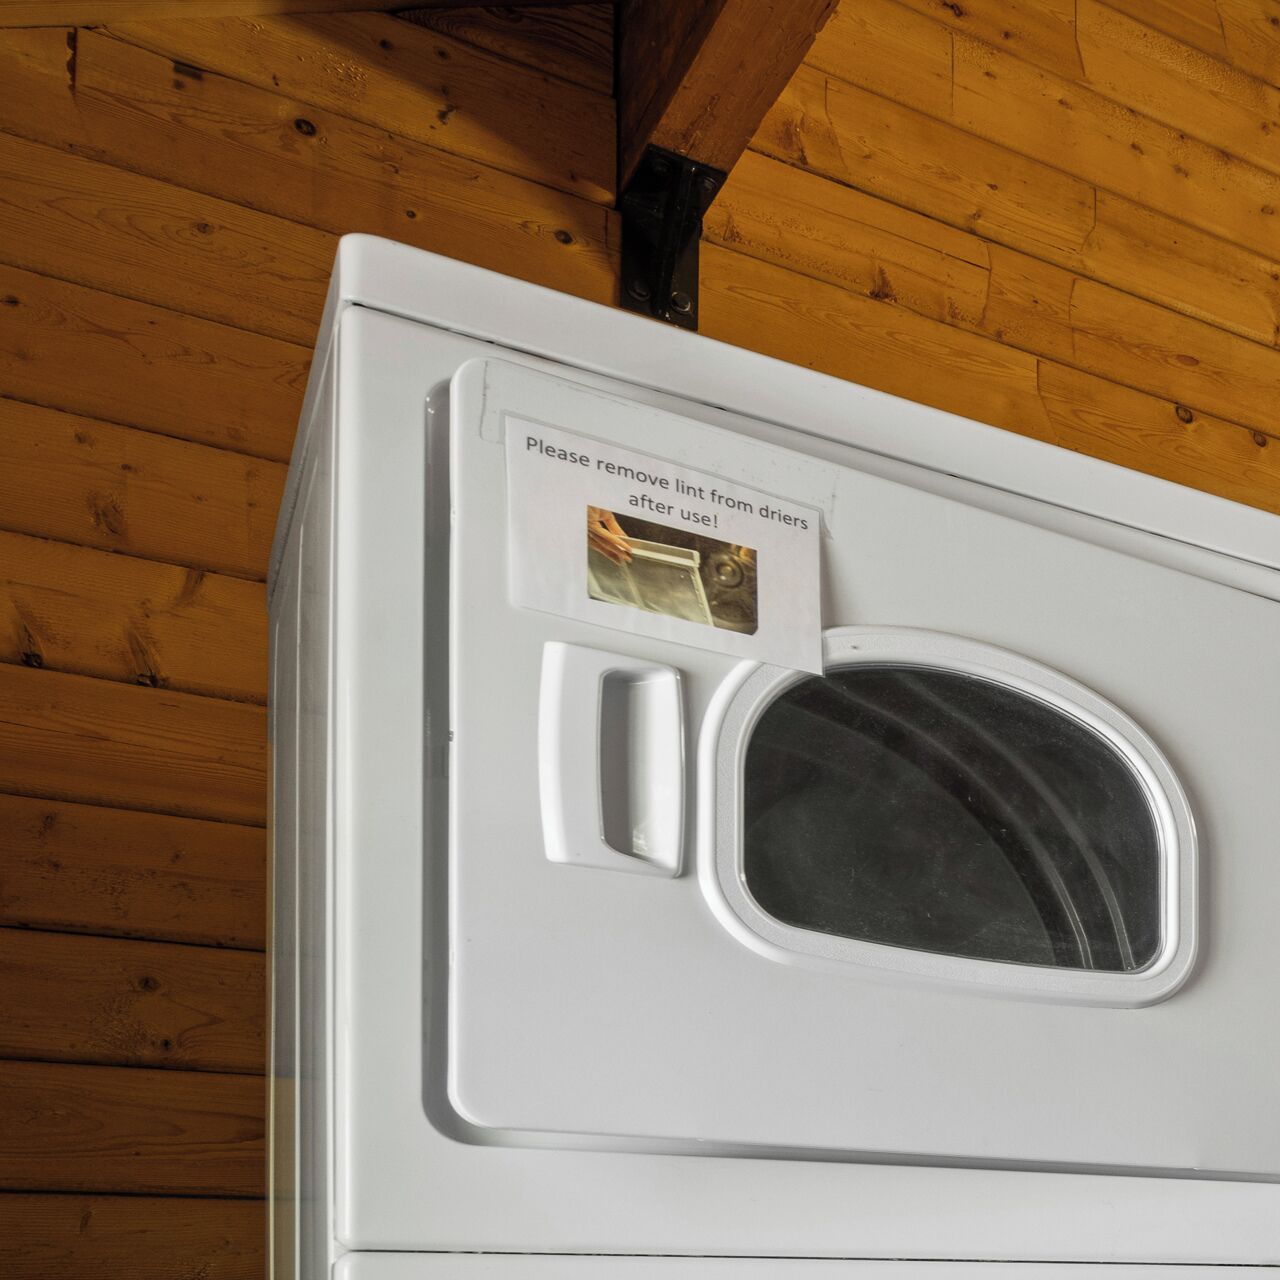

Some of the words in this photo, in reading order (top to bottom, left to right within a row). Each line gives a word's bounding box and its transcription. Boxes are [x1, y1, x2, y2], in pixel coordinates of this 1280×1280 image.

[527, 436, 590, 467] Please
[597, 460, 669, 490] remove
[676, 478, 705, 500] lint
[710, 489, 753, 514] from
[759, 505, 808, 530] driers
[629, 494, 674, 516] after
[681, 509, 718, 529] use!
